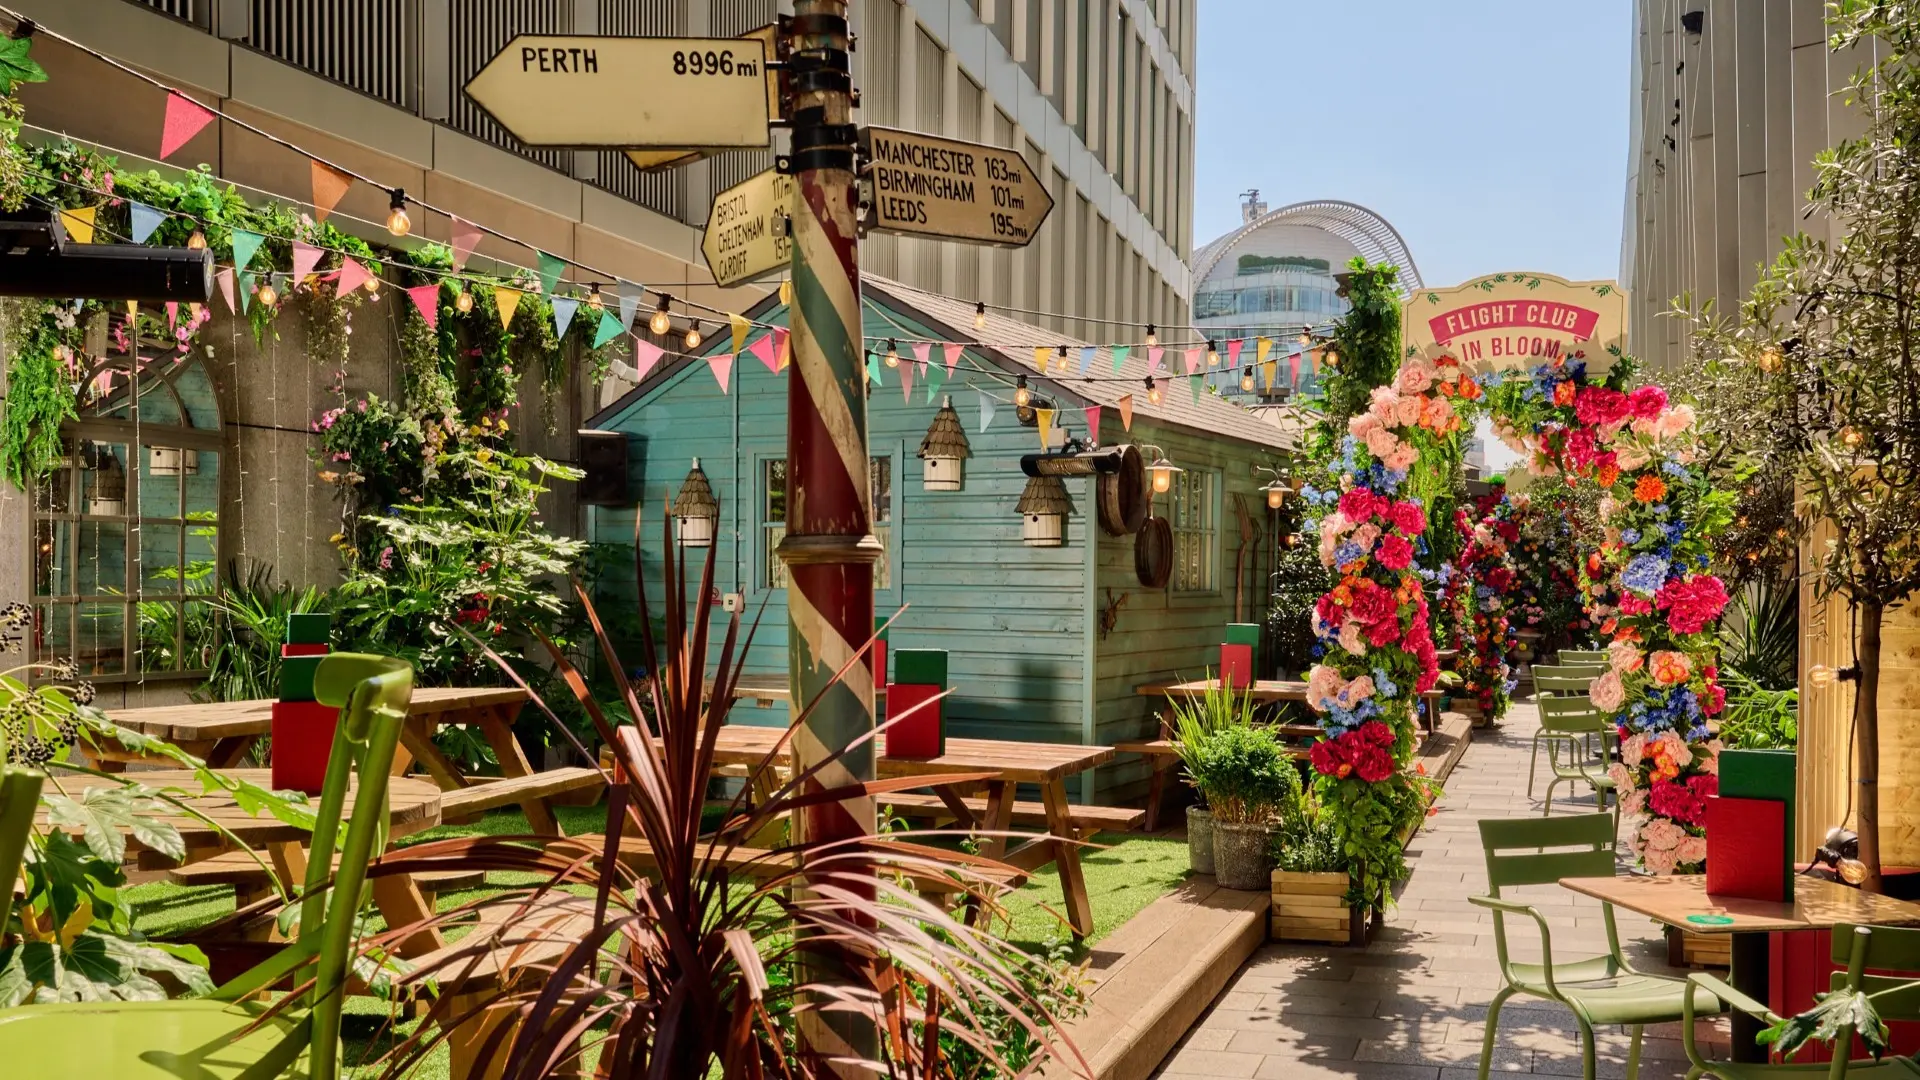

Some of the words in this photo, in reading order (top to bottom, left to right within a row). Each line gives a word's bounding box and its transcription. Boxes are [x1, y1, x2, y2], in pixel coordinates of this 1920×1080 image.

[522, 47, 598, 74] PERTH
[875, 138, 976, 177] MANCHESTER
[878, 167, 976, 203] BIRMINGHAM
[717, 194, 748, 227] BRISTOL
[881, 195, 928, 224] LEEDS
[718, 214, 765, 254] CHELTENHAM
[719, 250, 747, 281] CARDIFF
[1446, 304, 1517, 334] FLIGHT
[1526, 304, 1579, 329] CLUB
[1461, 340, 1482, 362] IN
[1491, 336, 1561, 359] BLOOM
